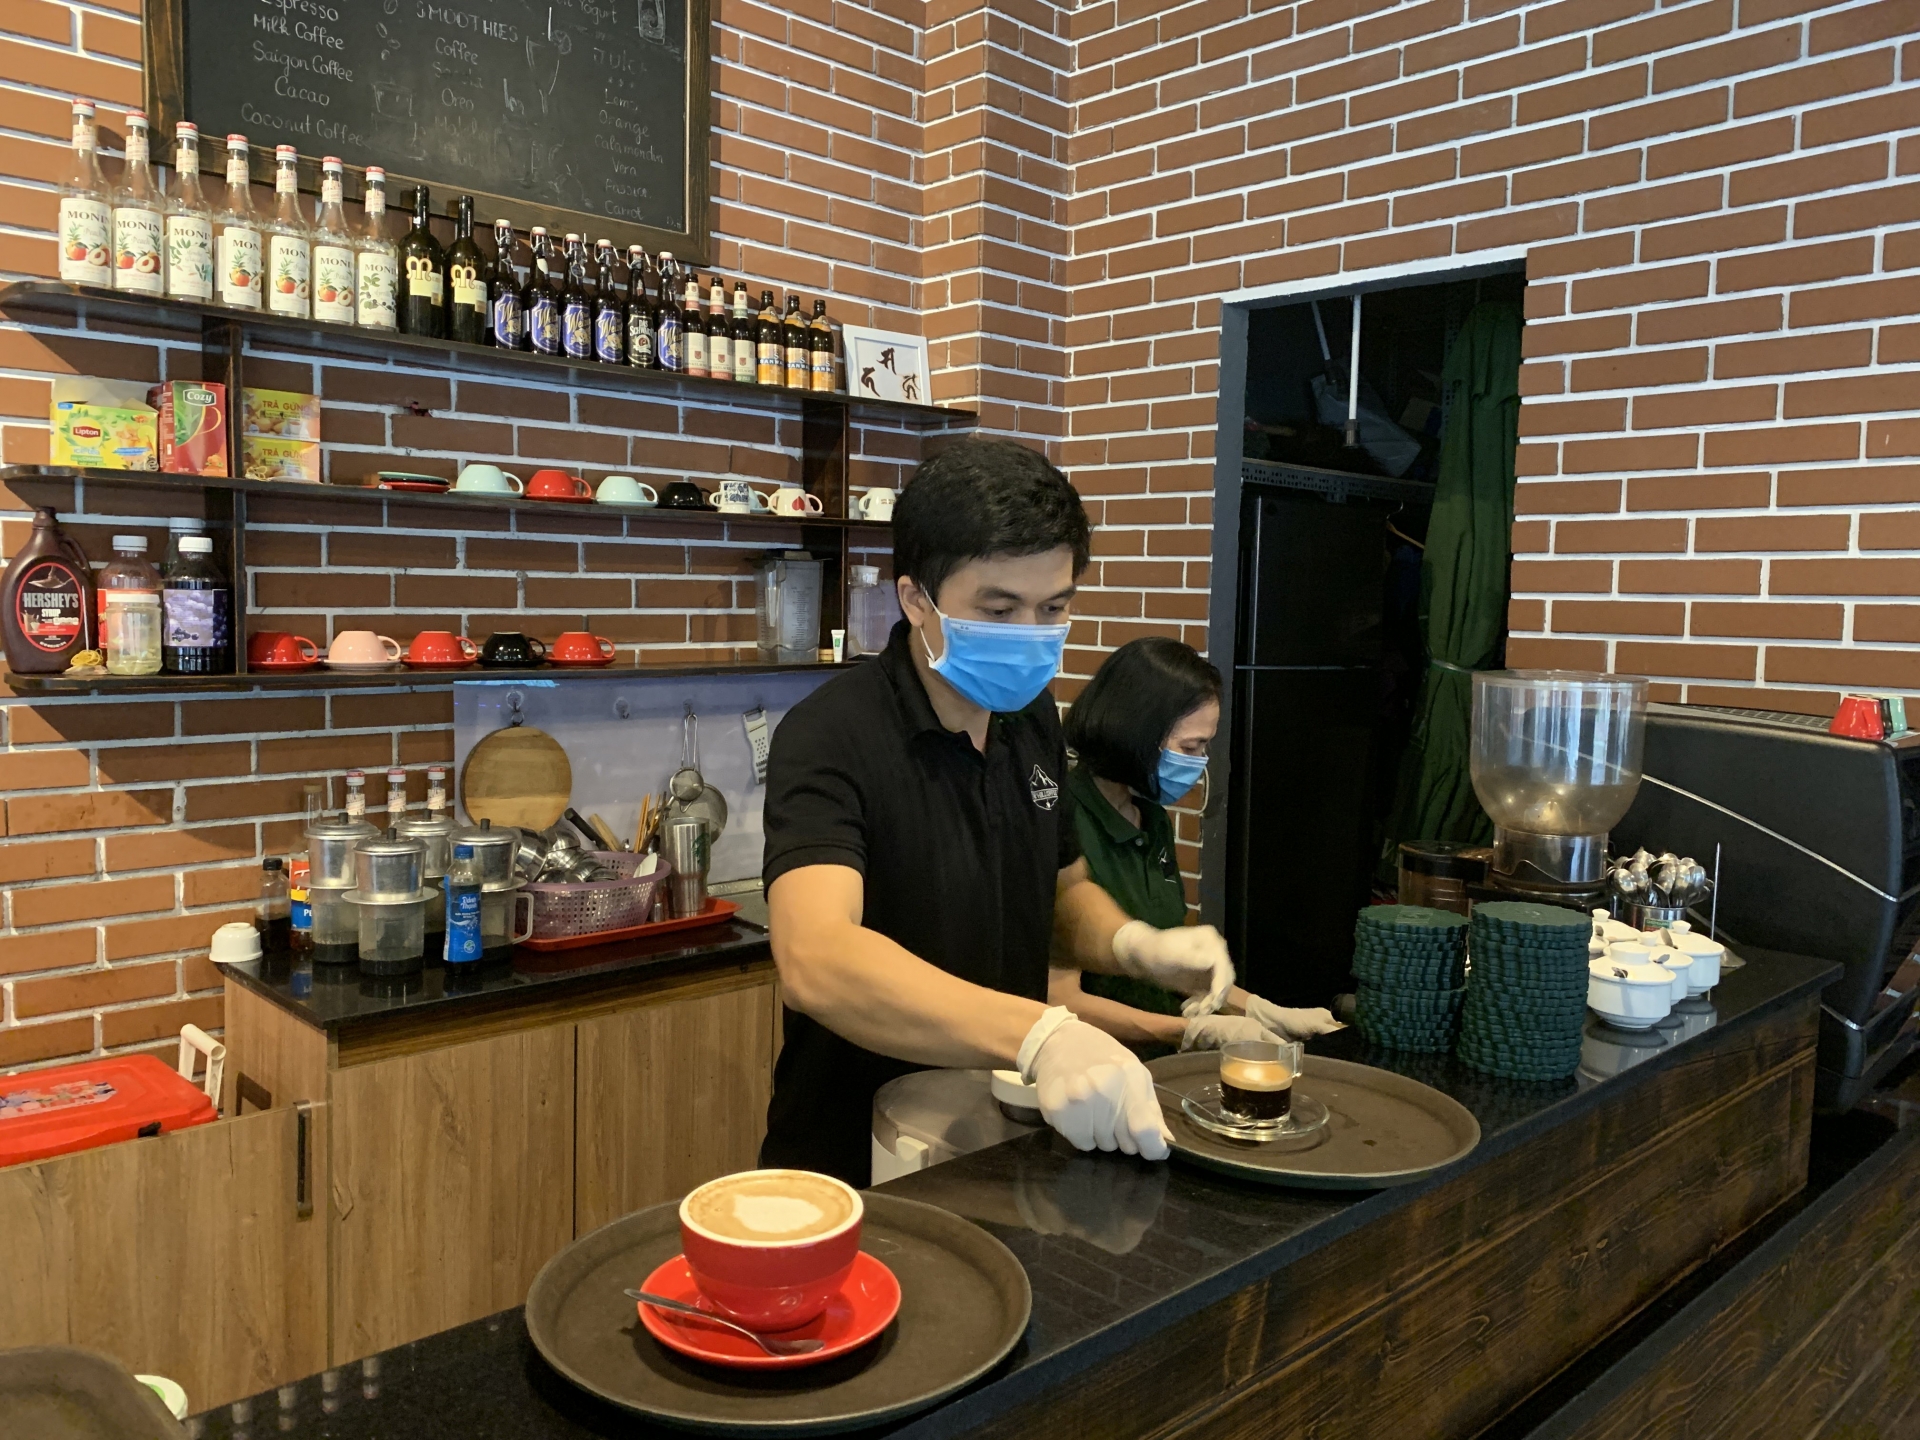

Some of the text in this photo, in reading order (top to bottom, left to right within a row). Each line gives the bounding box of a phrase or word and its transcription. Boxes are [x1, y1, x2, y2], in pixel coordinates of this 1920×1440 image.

[253, 13, 345, 50] Milk Coffee
[416, 1, 518, 43] SMOOTHIES
[253, 40, 354, 82] Saigon Coffee
[435, 37, 478, 65] Coffee
[274, 76, 330, 106] Cacao
[441, 88, 475, 112] Oreo
[241, 102, 364, 146] Coconut Coffee
[599, 110, 649, 144] Orange
[67, 209, 111, 224] MONIN
[605, 200, 645, 220] Carrot
[117, 220, 160, 233] MONIN
[187, 391, 213, 404] Cozy
[75, 428, 99, 436] Lipton
[23, 592, 79, 608] HERSHEY'S
